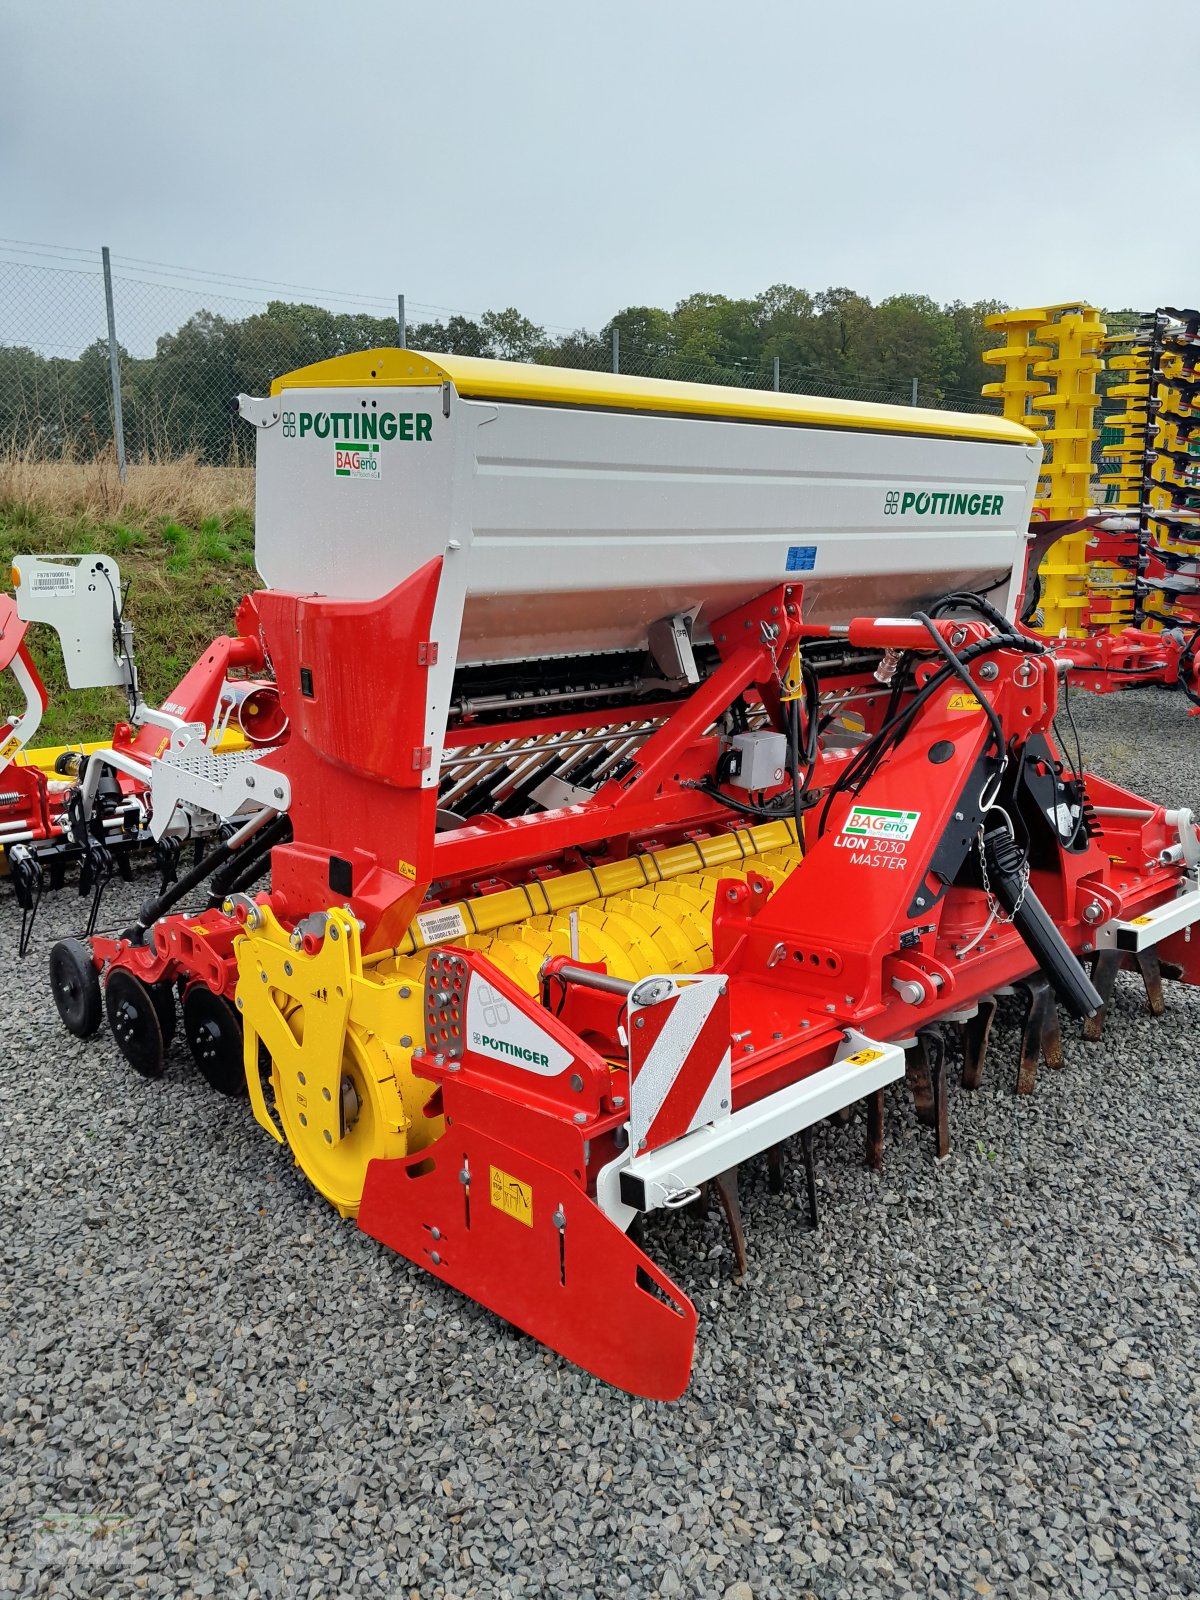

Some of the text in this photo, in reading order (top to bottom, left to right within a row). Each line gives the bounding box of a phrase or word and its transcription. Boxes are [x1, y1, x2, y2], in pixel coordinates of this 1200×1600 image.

[300, 412, 432, 441] PÖTTINGER
[336, 452, 377, 471] BAGeno
[901, 492, 1004, 515] PÖTTINGER
[849, 814, 907, 832] BAGeno
[834, 836, 905, 854] LION 3030
[850, 853, 907, 870] MASTER
[482, 1035, 549, 1067] PÖTTINGER
